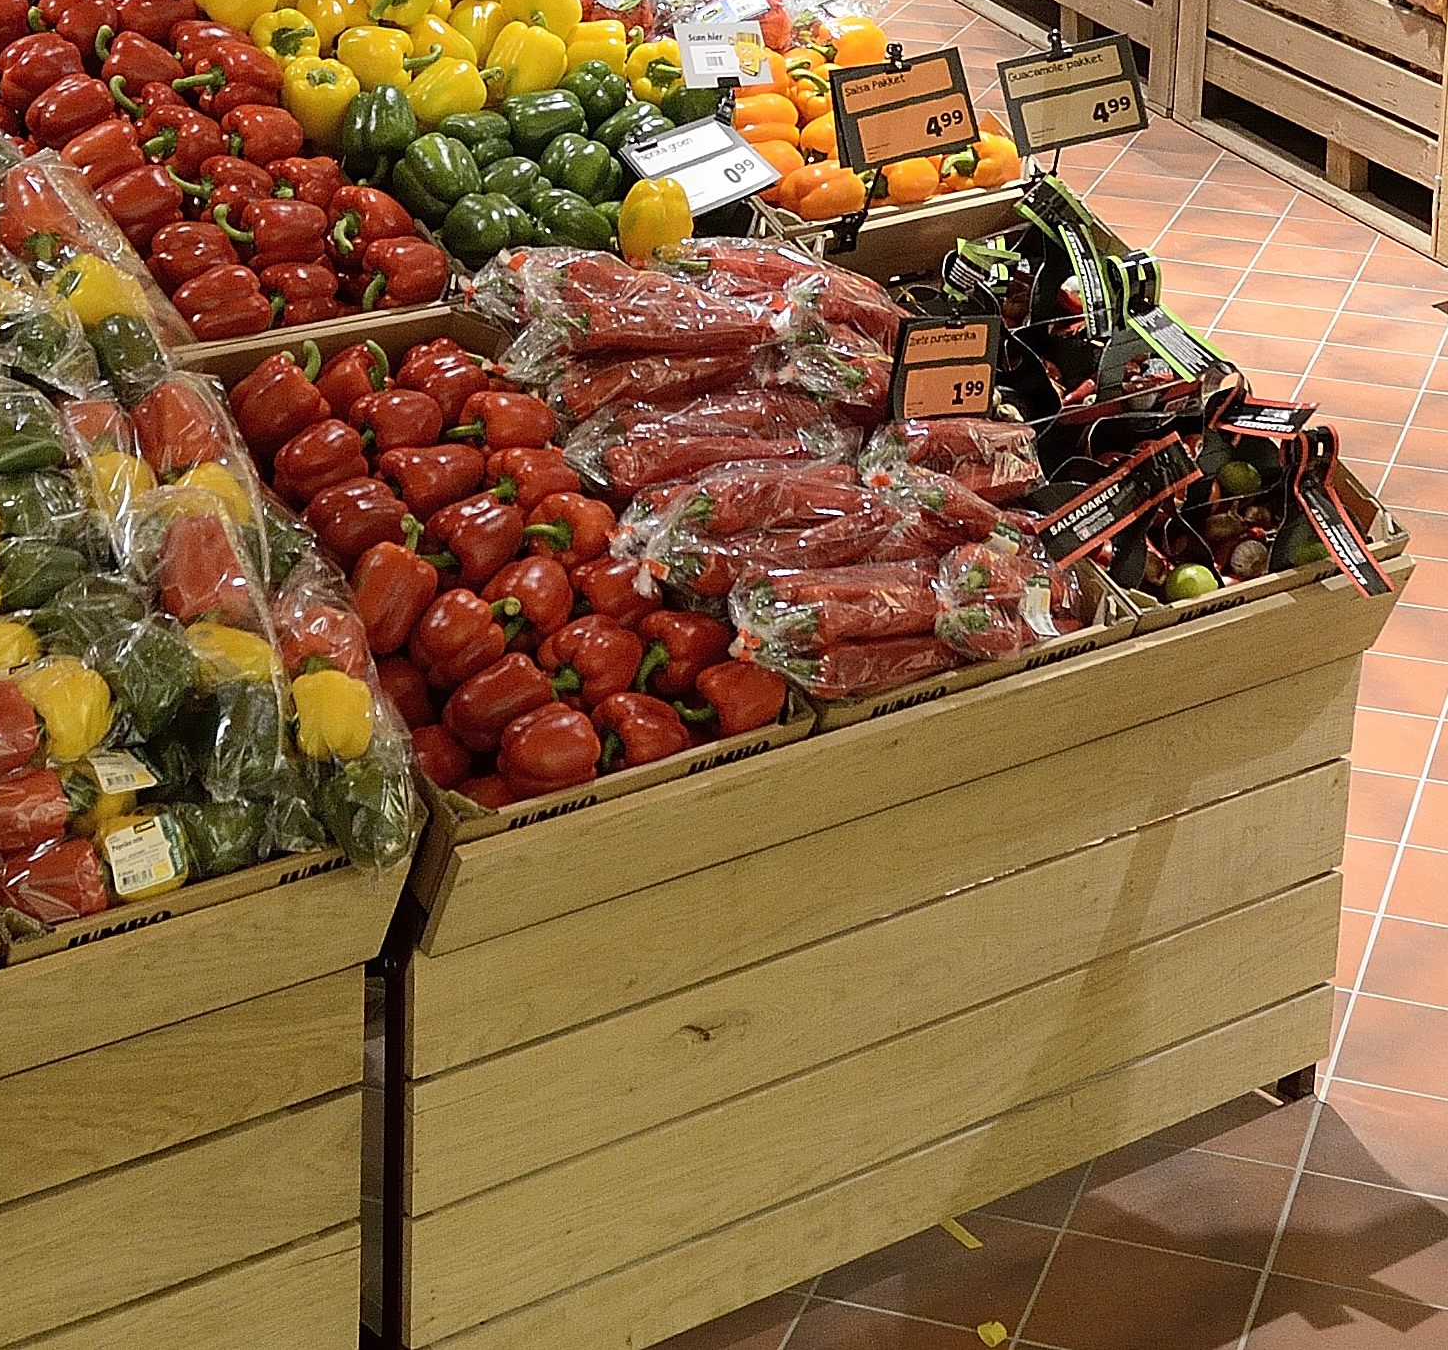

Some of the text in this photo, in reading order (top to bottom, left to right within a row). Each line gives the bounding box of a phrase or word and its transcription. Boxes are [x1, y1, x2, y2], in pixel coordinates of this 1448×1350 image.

[688, 32, 723, 41] Scan hier
[1008, 54, 1103, 83] Guacamole pakket
[844, 82, 870, 97] Salsa
[669, 136, 693, 152] groen
